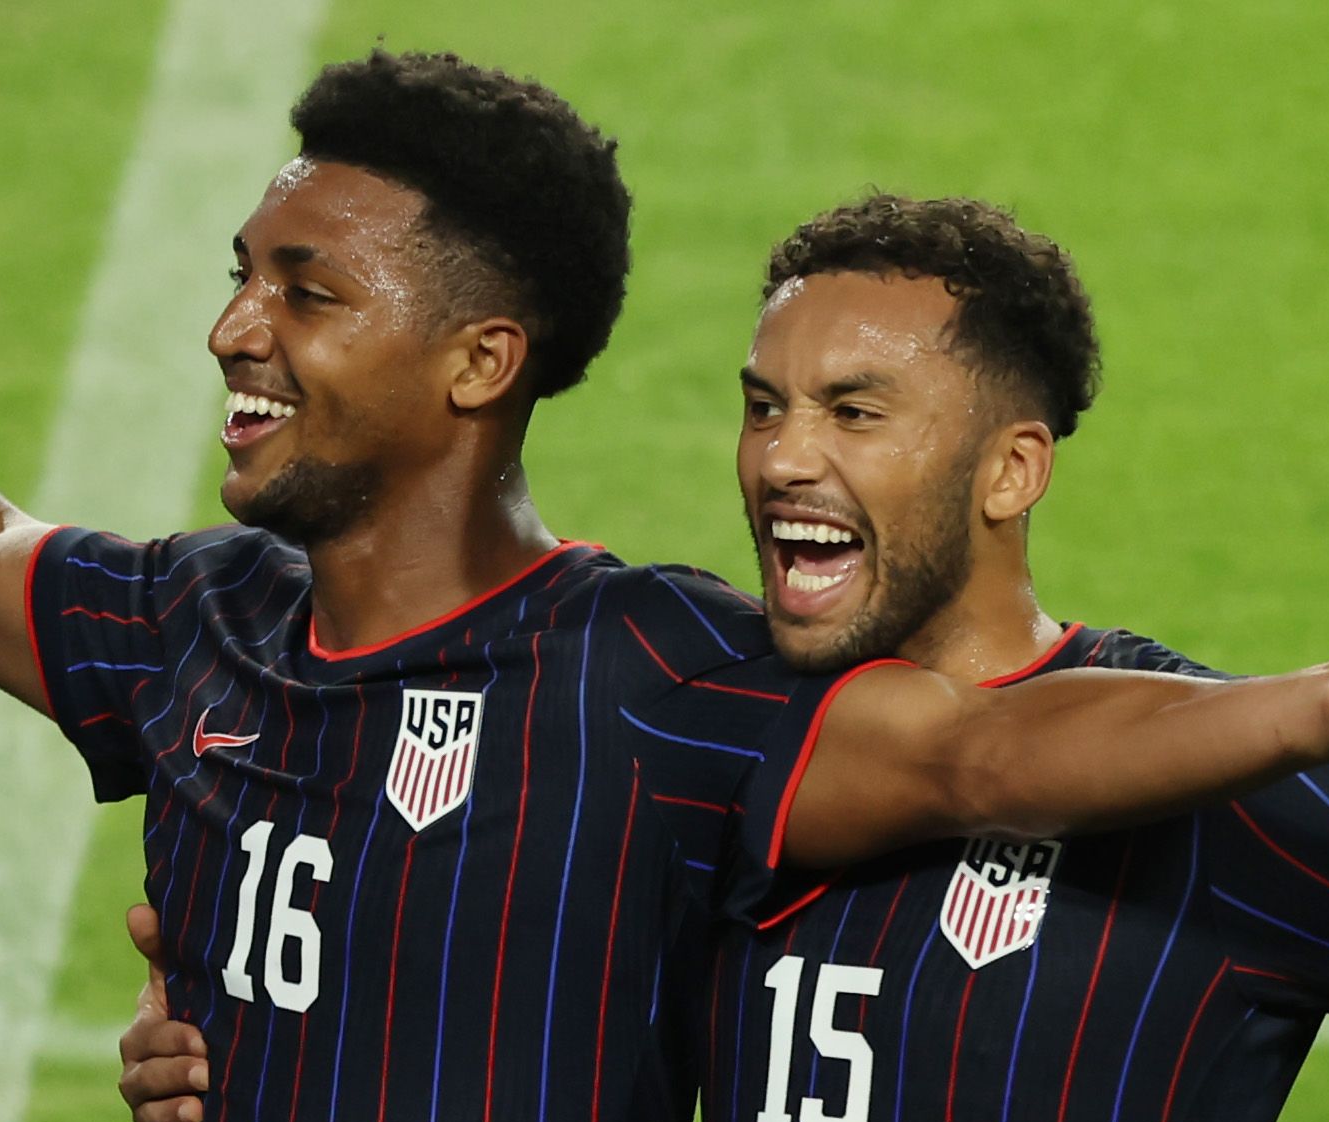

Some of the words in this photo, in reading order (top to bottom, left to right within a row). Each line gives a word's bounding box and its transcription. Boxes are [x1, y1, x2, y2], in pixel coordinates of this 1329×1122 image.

[407, 697, 475, 750] USA
[966, 838, 1054, 888] USA
[222, 820, 333, 1013] 16
